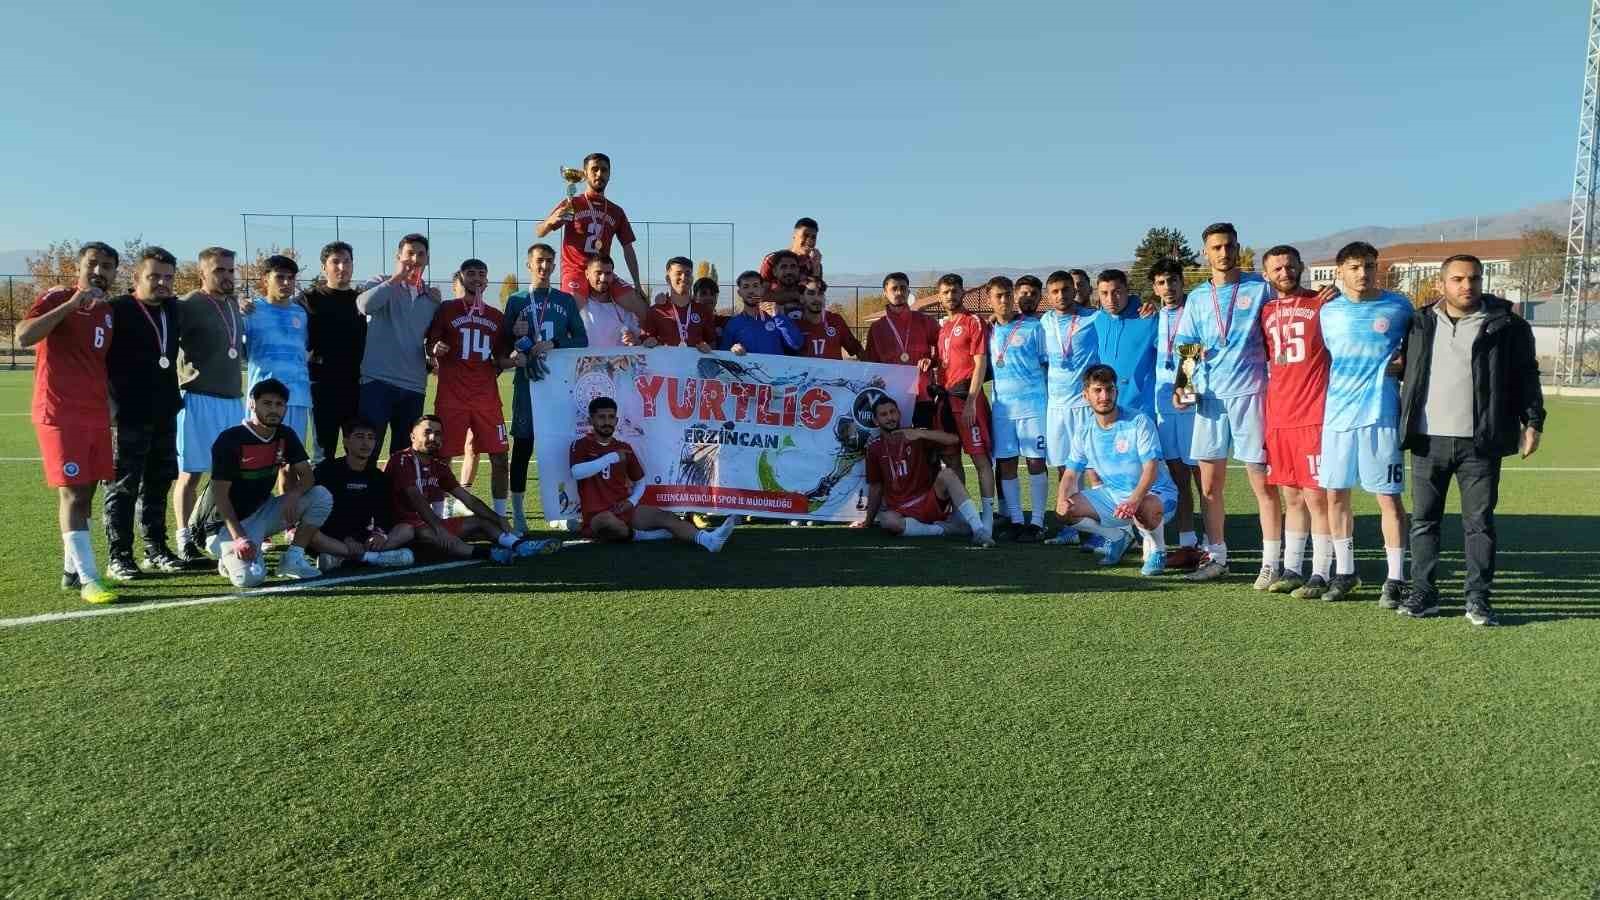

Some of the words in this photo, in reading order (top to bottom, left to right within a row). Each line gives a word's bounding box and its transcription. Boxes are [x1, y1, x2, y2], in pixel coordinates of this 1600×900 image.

[94, 326, 105, 348] 6
[459, 327, 492, 361] 14
[811, 338, 826, 355] 17
[1268, 321, 1305, 365] 15
[601, 463, 610, 480] 9
[718, 495, 737, 505] SPOR
